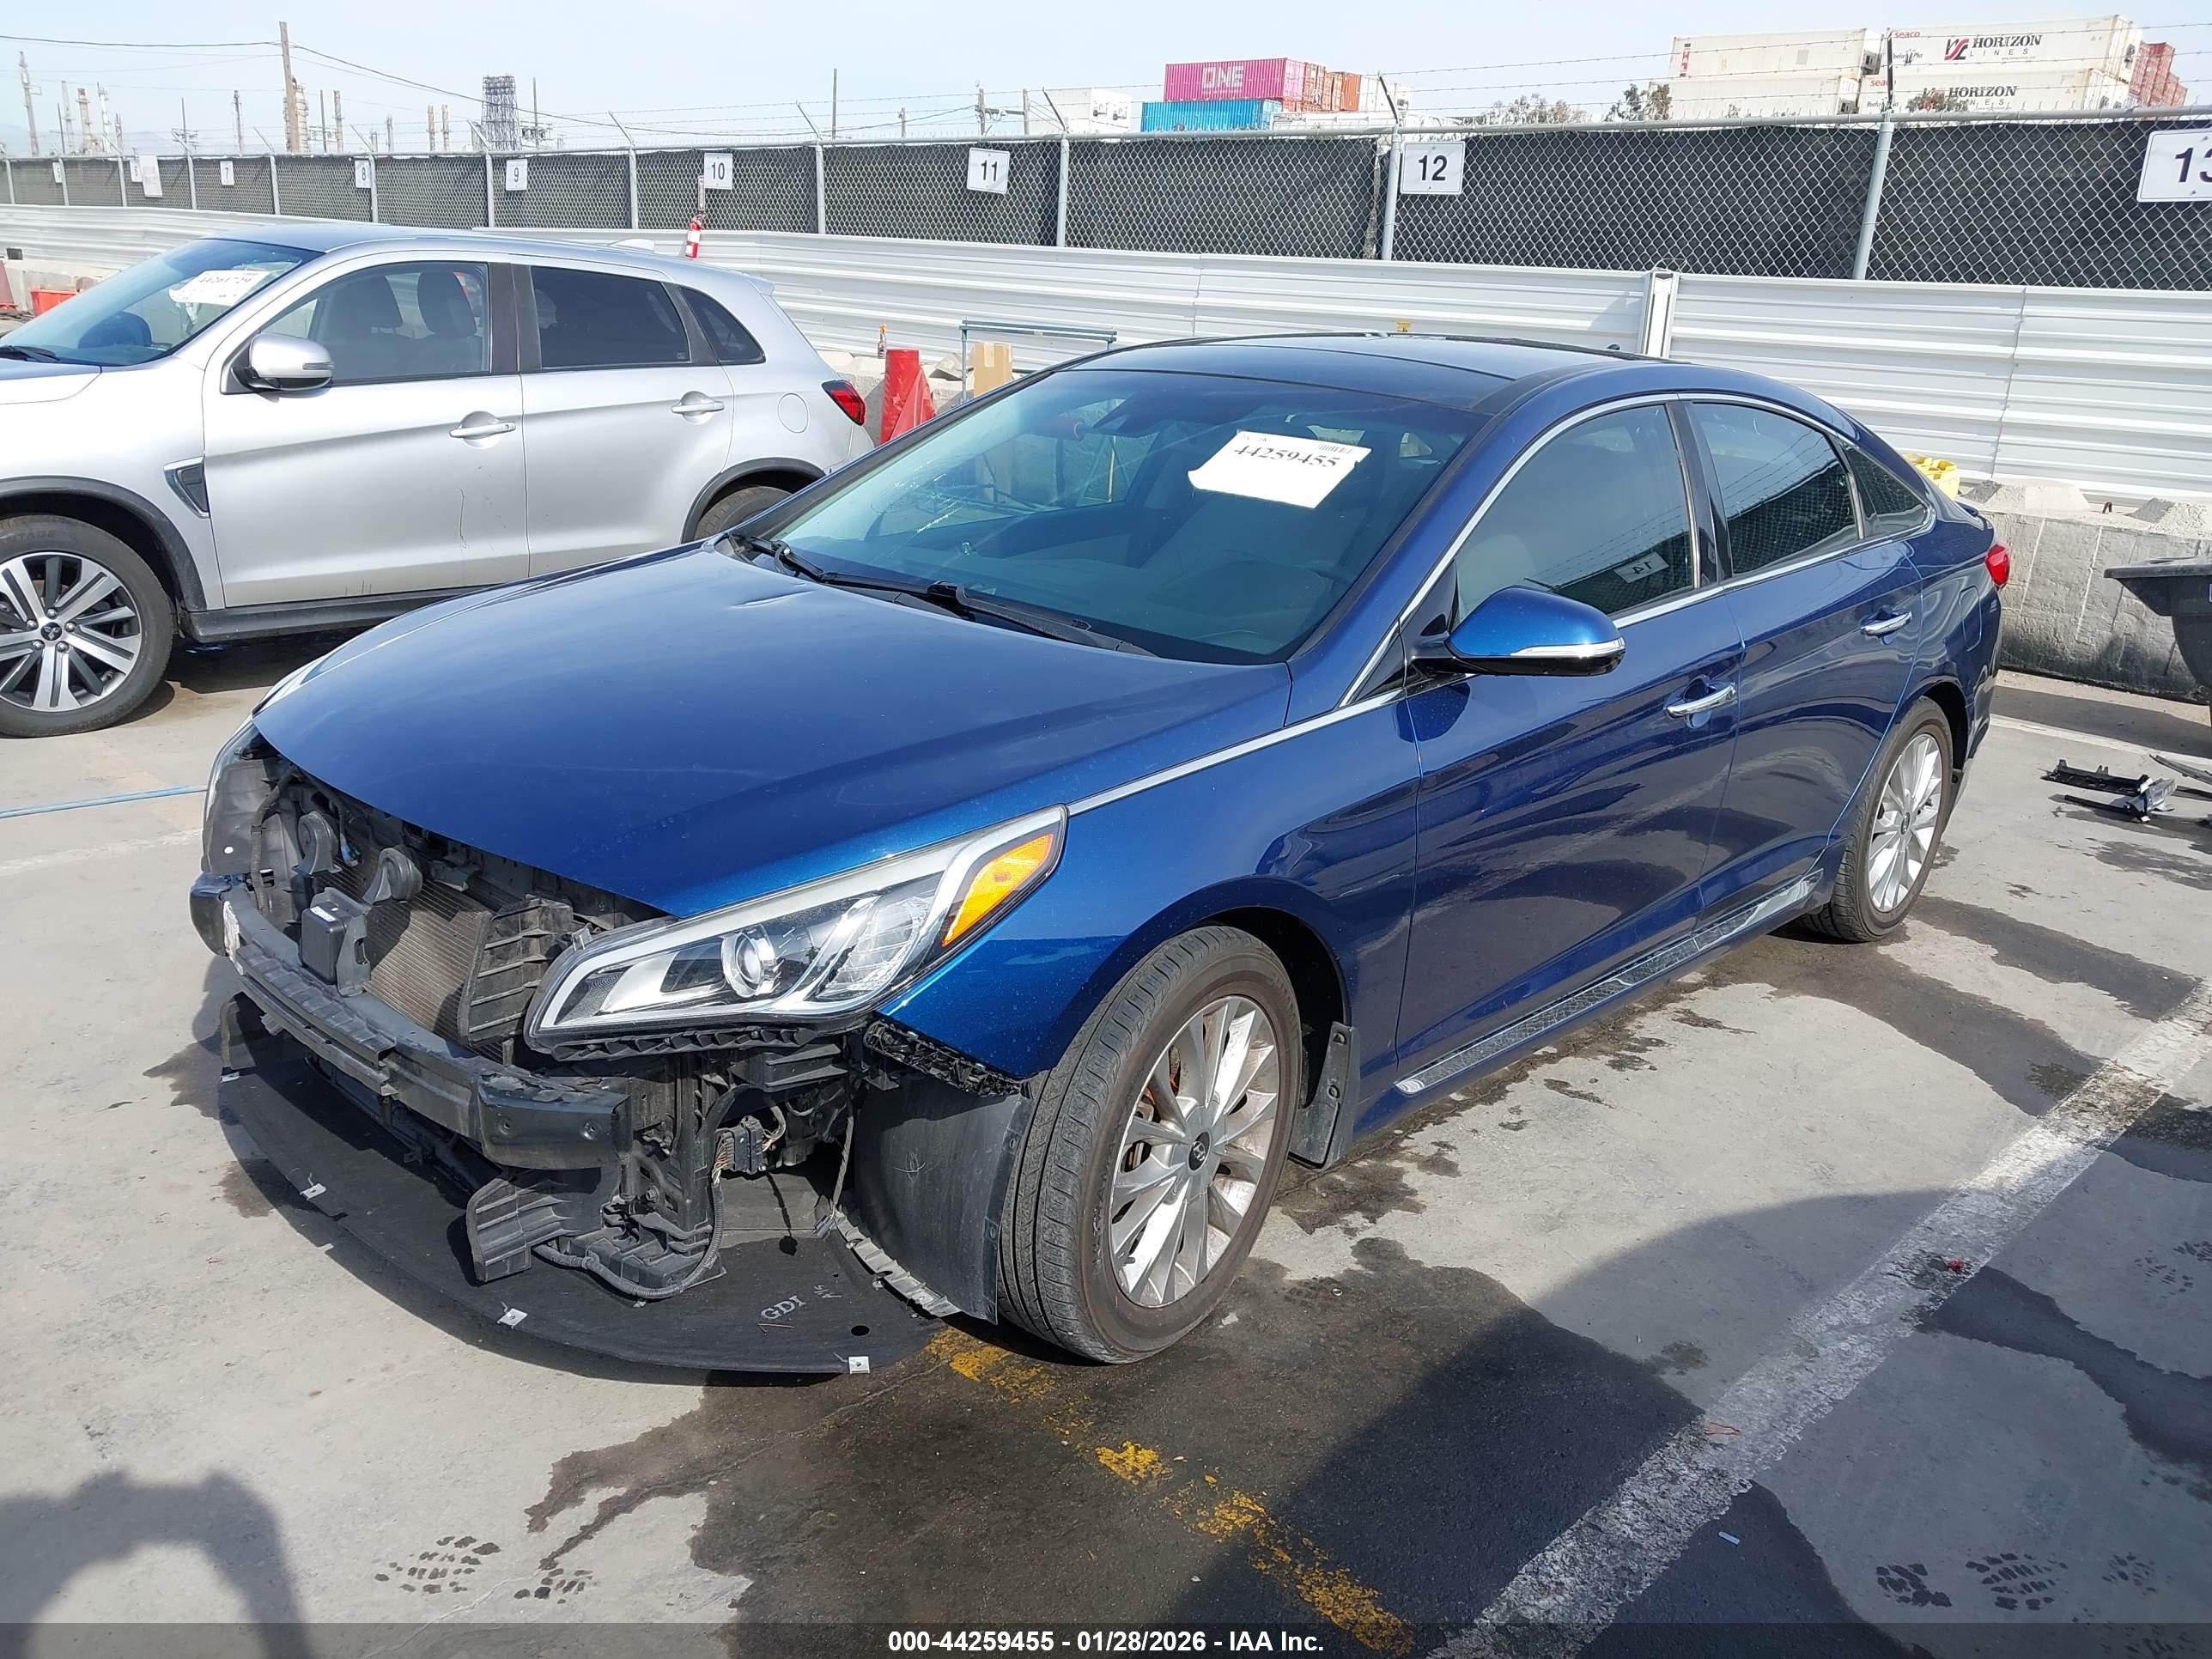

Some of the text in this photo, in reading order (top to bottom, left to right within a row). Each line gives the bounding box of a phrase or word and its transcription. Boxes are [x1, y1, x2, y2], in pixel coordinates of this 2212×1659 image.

[1972, 34, 2043, 48] HORIZON
[1970, 48, 2029, 58] LINES
[1202, 65, 1244, 88] ONE
[1948, 85, 2018, 98] HORIZON
[361, 167, 368, 181] 8
[514, 167, 520, 183] 9
[711, 161, 726, 180] 10
[981, 160, 998, 181] 11
[1419, 155, 1448, 181] 12
[1233, 445, 1341, 468] 44259455
[761, 1295, 807, 1321] GDI
